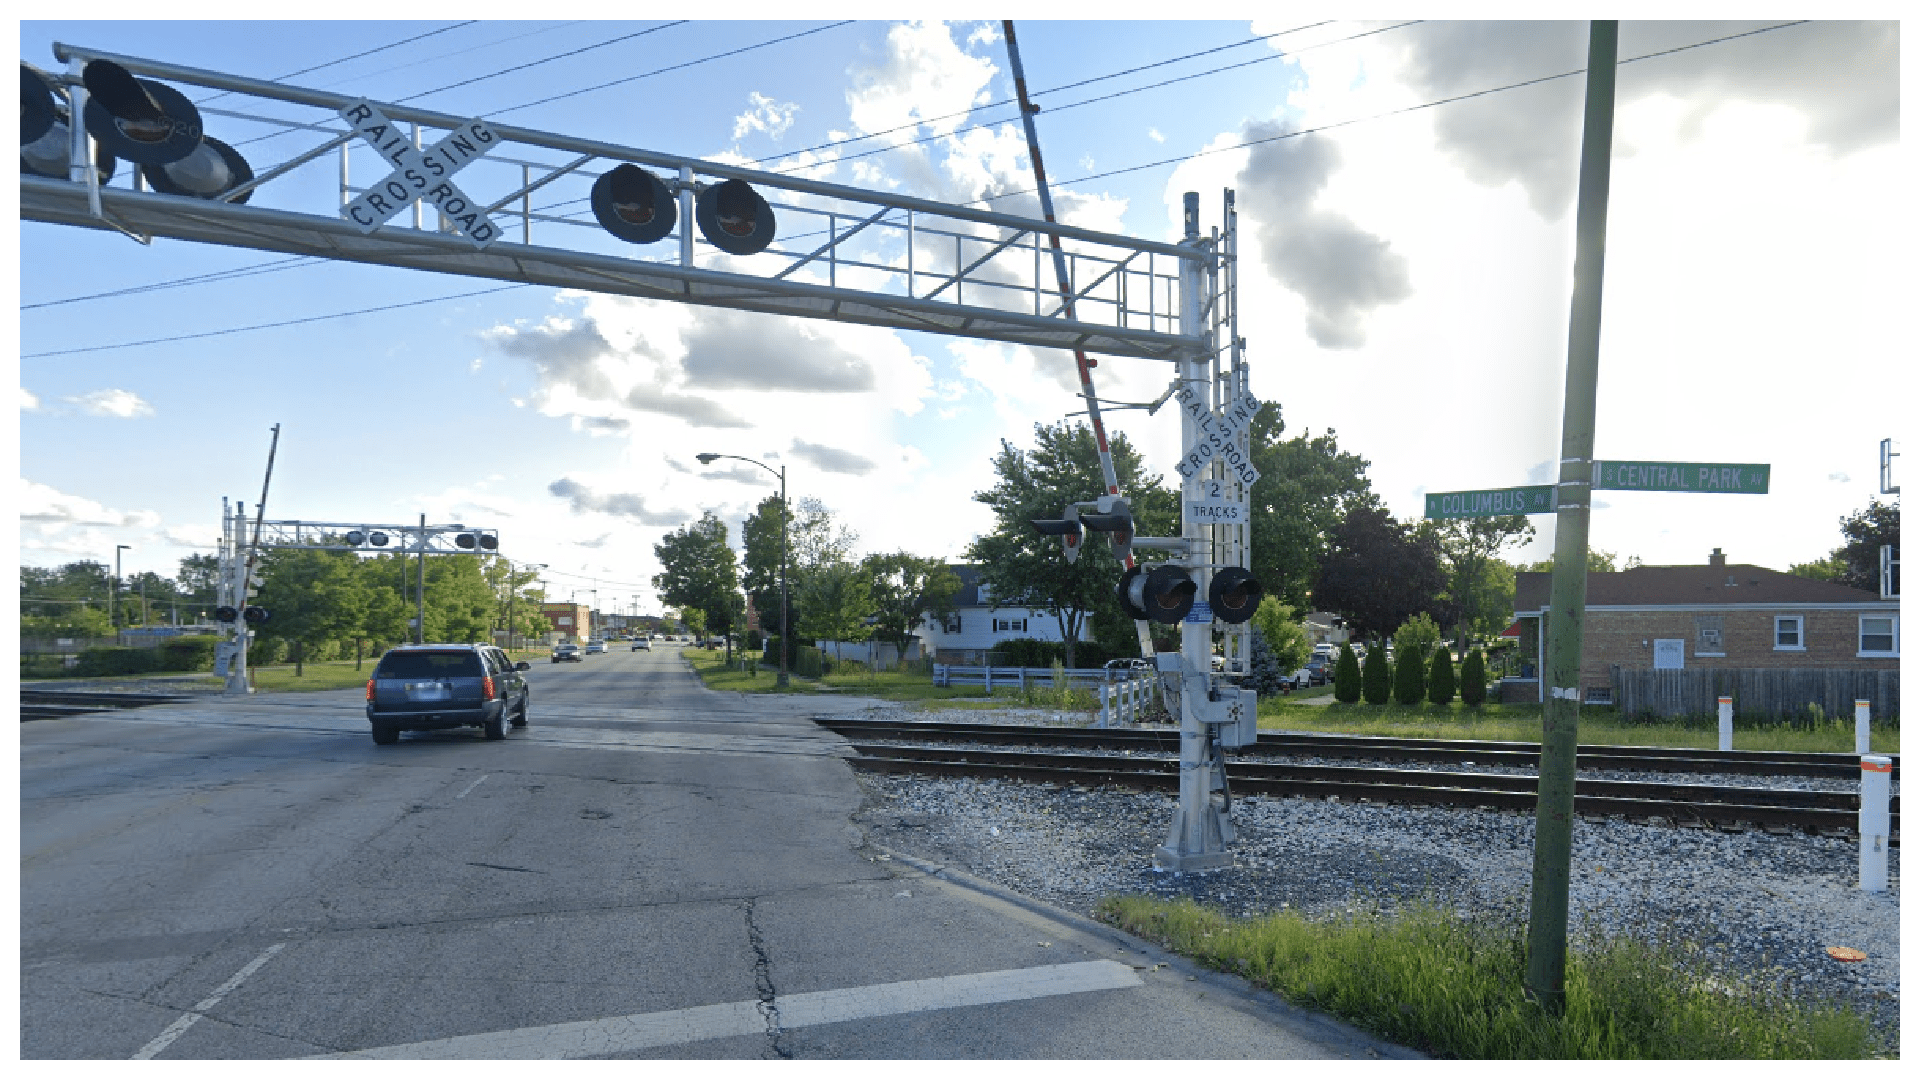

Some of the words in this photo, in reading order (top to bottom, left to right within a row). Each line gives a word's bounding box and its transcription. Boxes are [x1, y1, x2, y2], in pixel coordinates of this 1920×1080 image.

[347, 103, 409, 167] RAIL
[429, 183, 493, 242] ROAD
[350, 124, 493, 226] CROSSING
[1180, 389, 1212, 432] RAIL
[1221, 442, 1255, 483] ROAD
[1181, 397, 1257, 478] CROSSING
[1211, 482, 1220, 497] 2
[1442, 490, 1525, 514] COLUMBUS
[1617, 464, 1690, 489] CENTRAL
[1698, 467, 1742, 489] PARK
[1193, 506, 1237, 519] TRACKS
